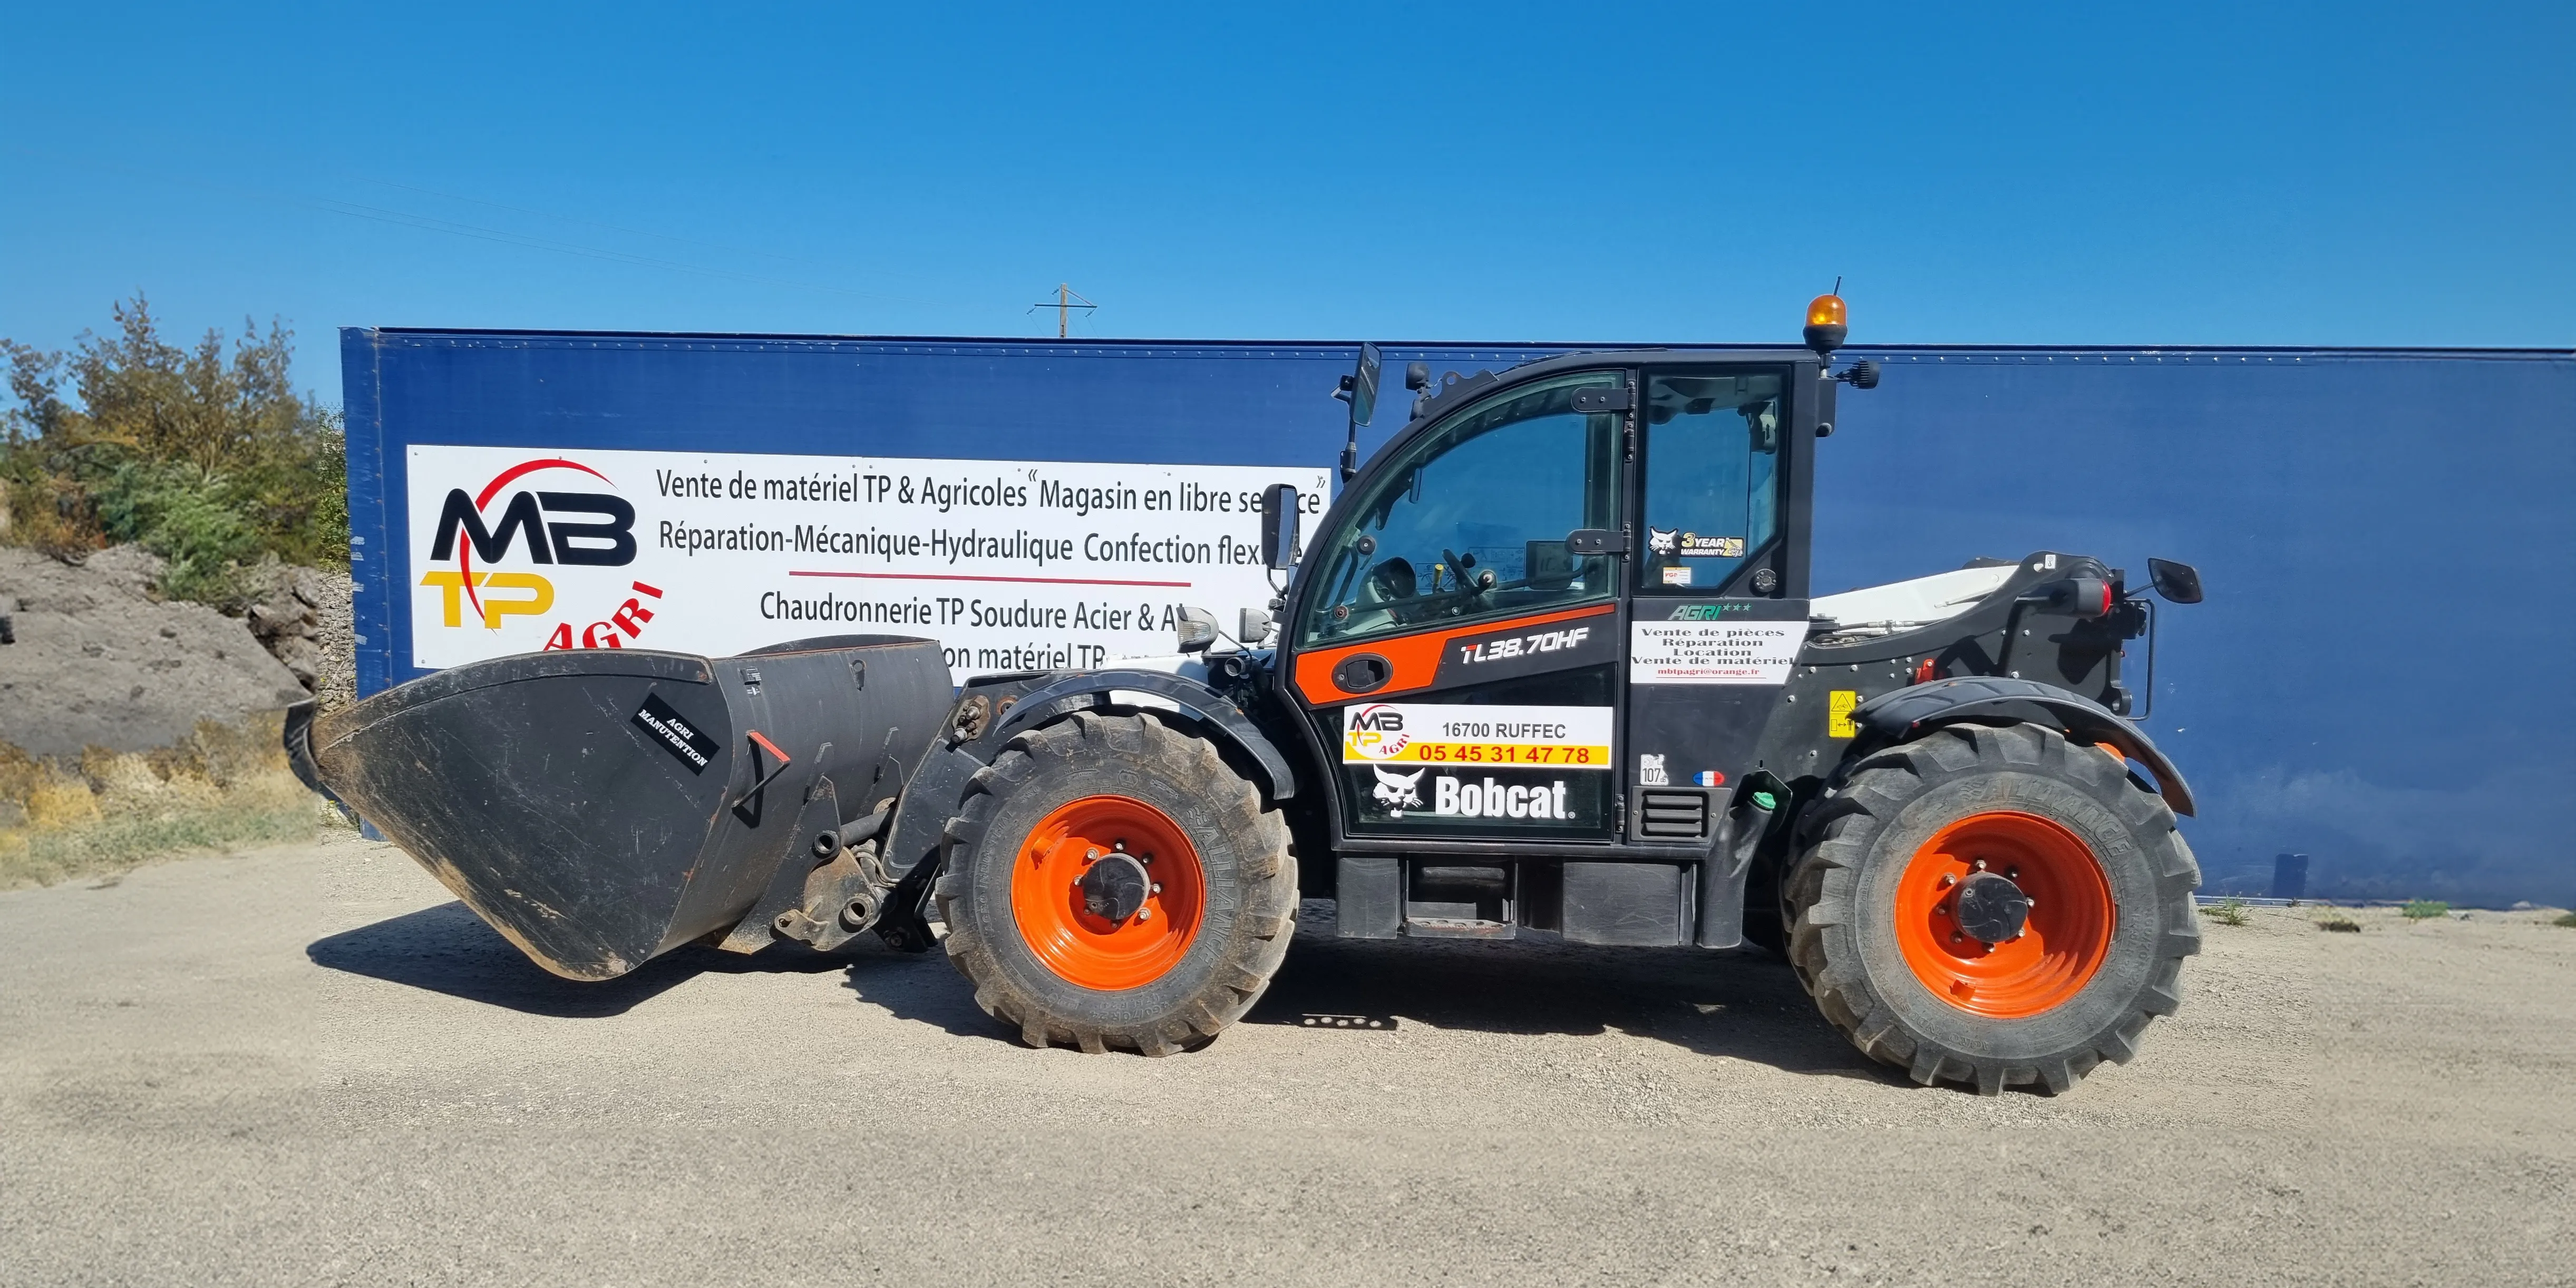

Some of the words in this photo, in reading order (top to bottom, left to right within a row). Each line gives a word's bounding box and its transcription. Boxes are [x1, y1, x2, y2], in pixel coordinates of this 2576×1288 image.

[656, 469, 722, 498] Vente
[729, 470, 757, 500] de
[764, 472, 858, 502] matériel
[863, 475, 891, 503] TP
[898, 475, 915, 504] &
[921, 476, 1027, 513] Agricoles
[1144, 490, 1171, 511] en
[1180, 482, 1231, 512] libre
[430, 488, 637, 567] MB
[660, 520, 1073, 567] Réparation-Mécanique-Hydraulique
[1084, 532, 1210, 564] Confection
[1681, 532, 1695, 547] 3
[1695, 538, 1725, 547] YEAR
[420, 571, 555, 629] TP
[761, 591, 932, 625] Chaudronnerie
[936, 597, 964, 625] TP
[970, 599, 1066, 629] Soudure
[1073, 601, 1132, 630] Acier
[1138, 603, 1154, 631] &
[543, 581, 663, 652] AGRI
[1667, 605, 1722, 621] AGRI
[1663, 638, 1763, 648] Réparation
[1698, 628, 1719, 637] de
[1727, 628, 1785, 638] pièces
[978, 642, 1071, 669] matériel
[1077, 644, 1105, 669] TP
[1460, 627, 1589, 664] TL38.70HF
[1631, 656, 1681, 665] Vente
[1717, 657, 1793, 665] matériel
[666, 718, 694, 740] AGRI
[1349, 711, 1403, 731] MB
[1443, 722, 1490, 737] 16700
[1495, 723, 1566, 739] RUFFEC
[638, 709, 708, 766] MANUTENTION
[1347, 731, 1382, 746] TP
[1379, 734, 1409, 755] AGRI
[1420, 745, 1446, 760] 05
[1454, 745, 1482, 761] 45
[1491, 746, 1514, 762] 31
[1526, 747, 1553, 763] 47
[1562, 747, 1589, 763] 78
[1642, 768, 1661, 783] 107
[1980, 778, 2134, 857] ALLIANCE
[1193, 826, 1236, 970] ALLIANCE
